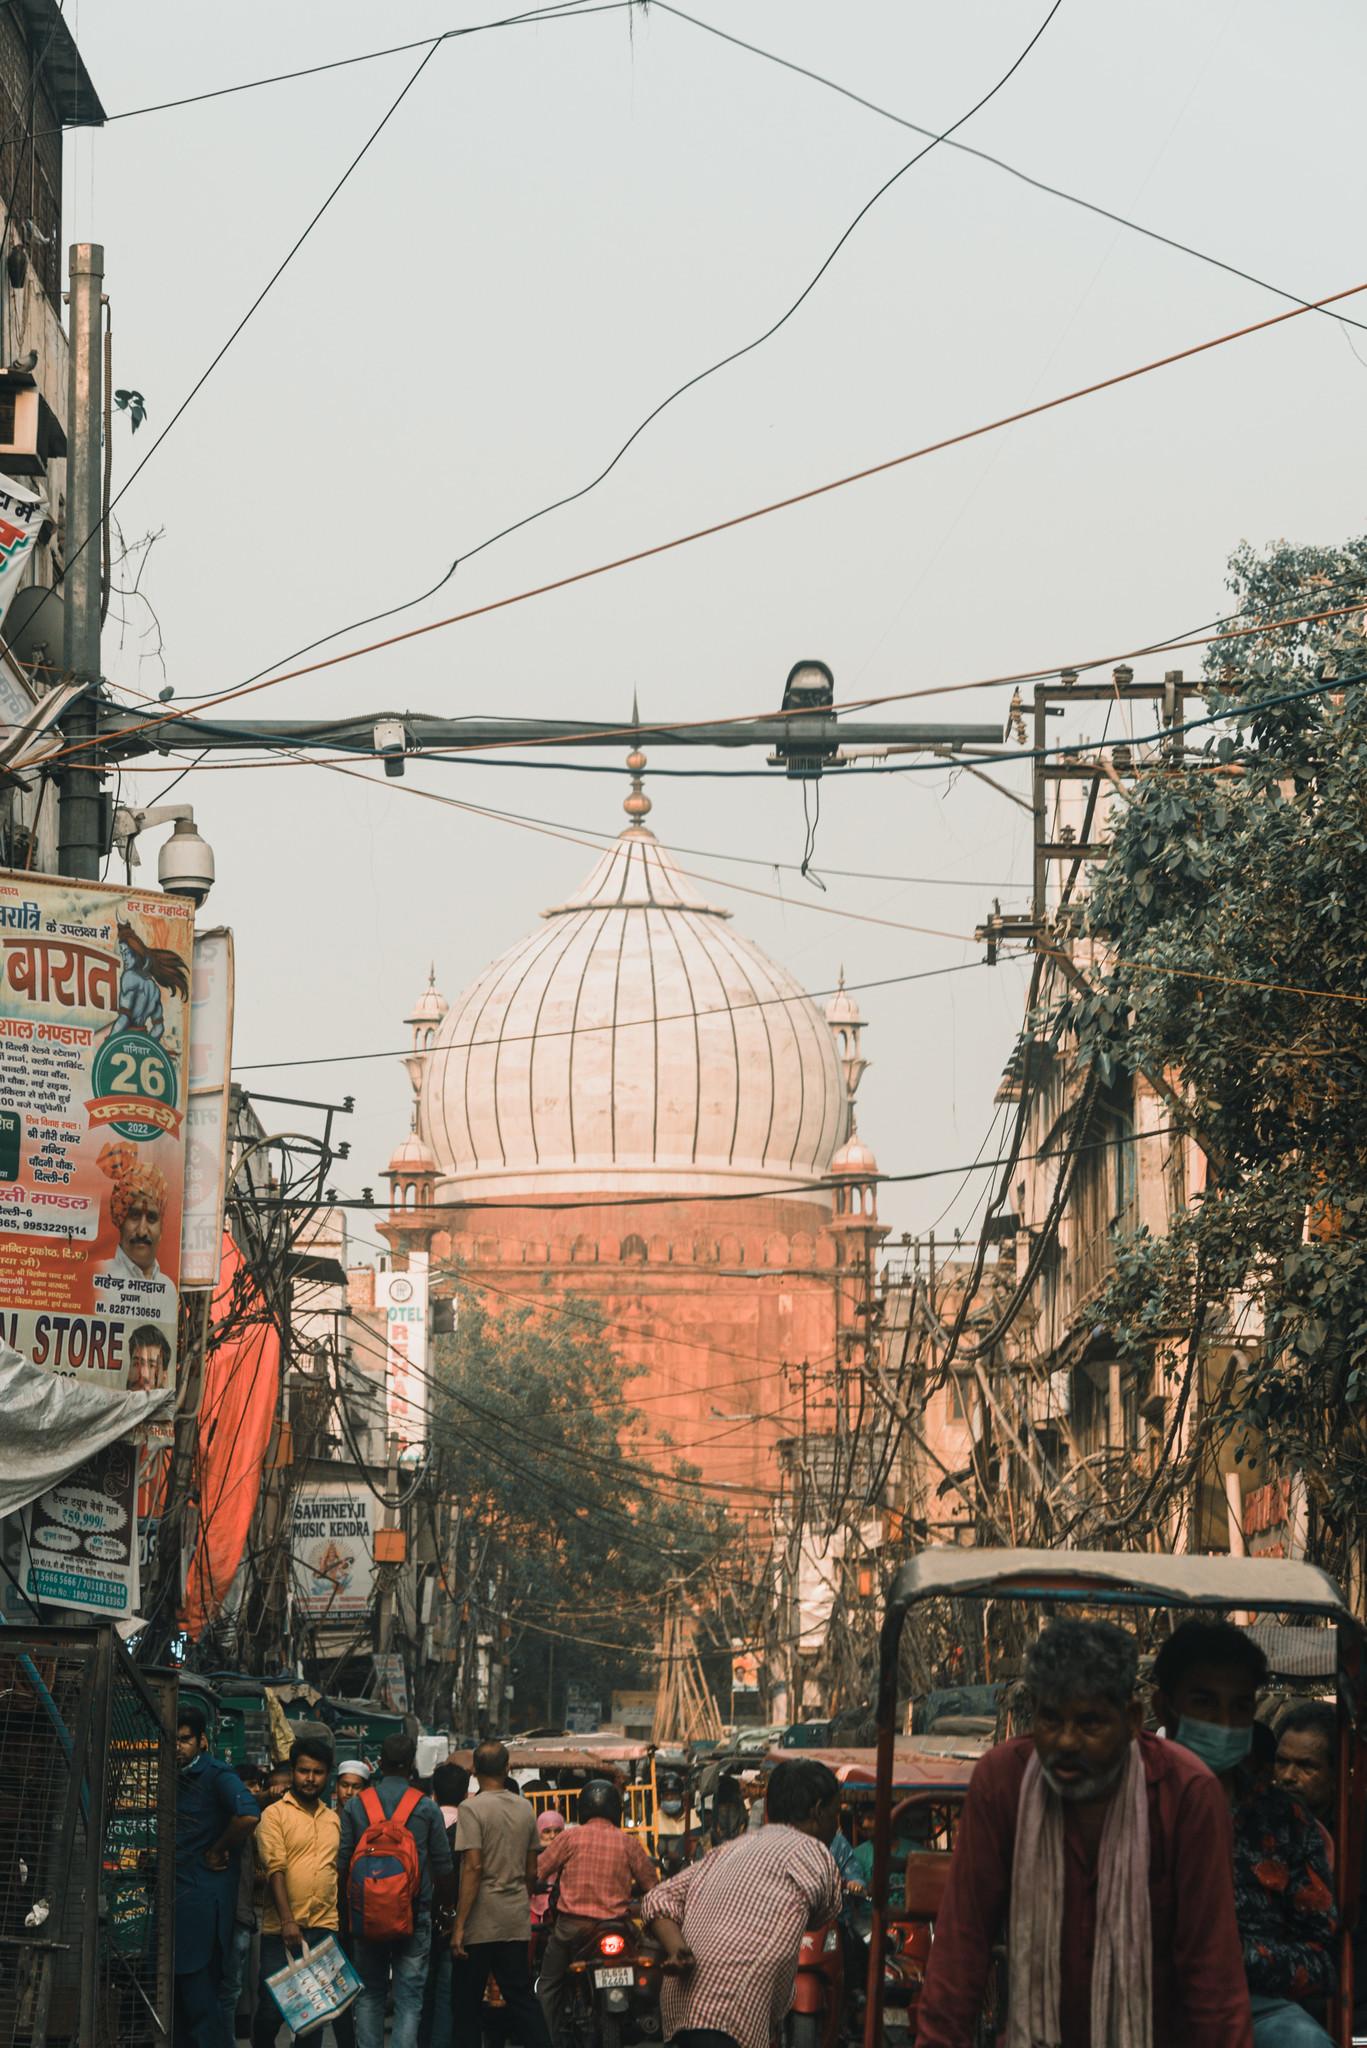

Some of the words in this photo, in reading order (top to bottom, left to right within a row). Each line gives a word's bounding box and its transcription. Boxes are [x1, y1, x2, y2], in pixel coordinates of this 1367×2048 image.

[127, 902, 140, 912] हर
[143, 904, 156, 914] हर
[158, 903, 190, 917] महादेव
[46, 919, 57, 933] के
[60, 924, 97, 938] उपलक्ष्य
[100, 925, 110, 939] में
[3, 939, 121, 1011] बारात
[38, 1024, 93, 1046] भण्डारा
[6, 1041, 29, 1052] दिल्ली
[123, 1043, 151, 1055] शनिवार
[110, 1053, 166, 1097] 26
[91, 1103, 176, 1130] फरवरी
[27, 1127, 38, 1139] श्री
[40, 1129, 58, 1140] गौरी
[60, 1131, 81, 1144] शंकर
[128, 1122, 149, 1134] 2022
[41, 1143, 66, 1156] मन्दिर
[56, 1158, 76, 1171] चौक,
[31, 1192, 90, 1210] मण्डल
[23, 1221, 87, 1235] 9953229514
[94, 1274, 125, 1290] महेन्द्र
[127, 1280, 166, 1294] भारद्वाज
[120, 1294, 140, 1302] प्रधान
[96, 1302, 106, 1312] M.
[109, 1304, 161, 1318] 8287130650
[33, 1315, 125, 1371] STORE
[294, 1503, 365, 1519] SAWHNEYJI
[293, 1522, 325, 1537] MUSIC
[330, 1521, 369, 1536] KENDRA
